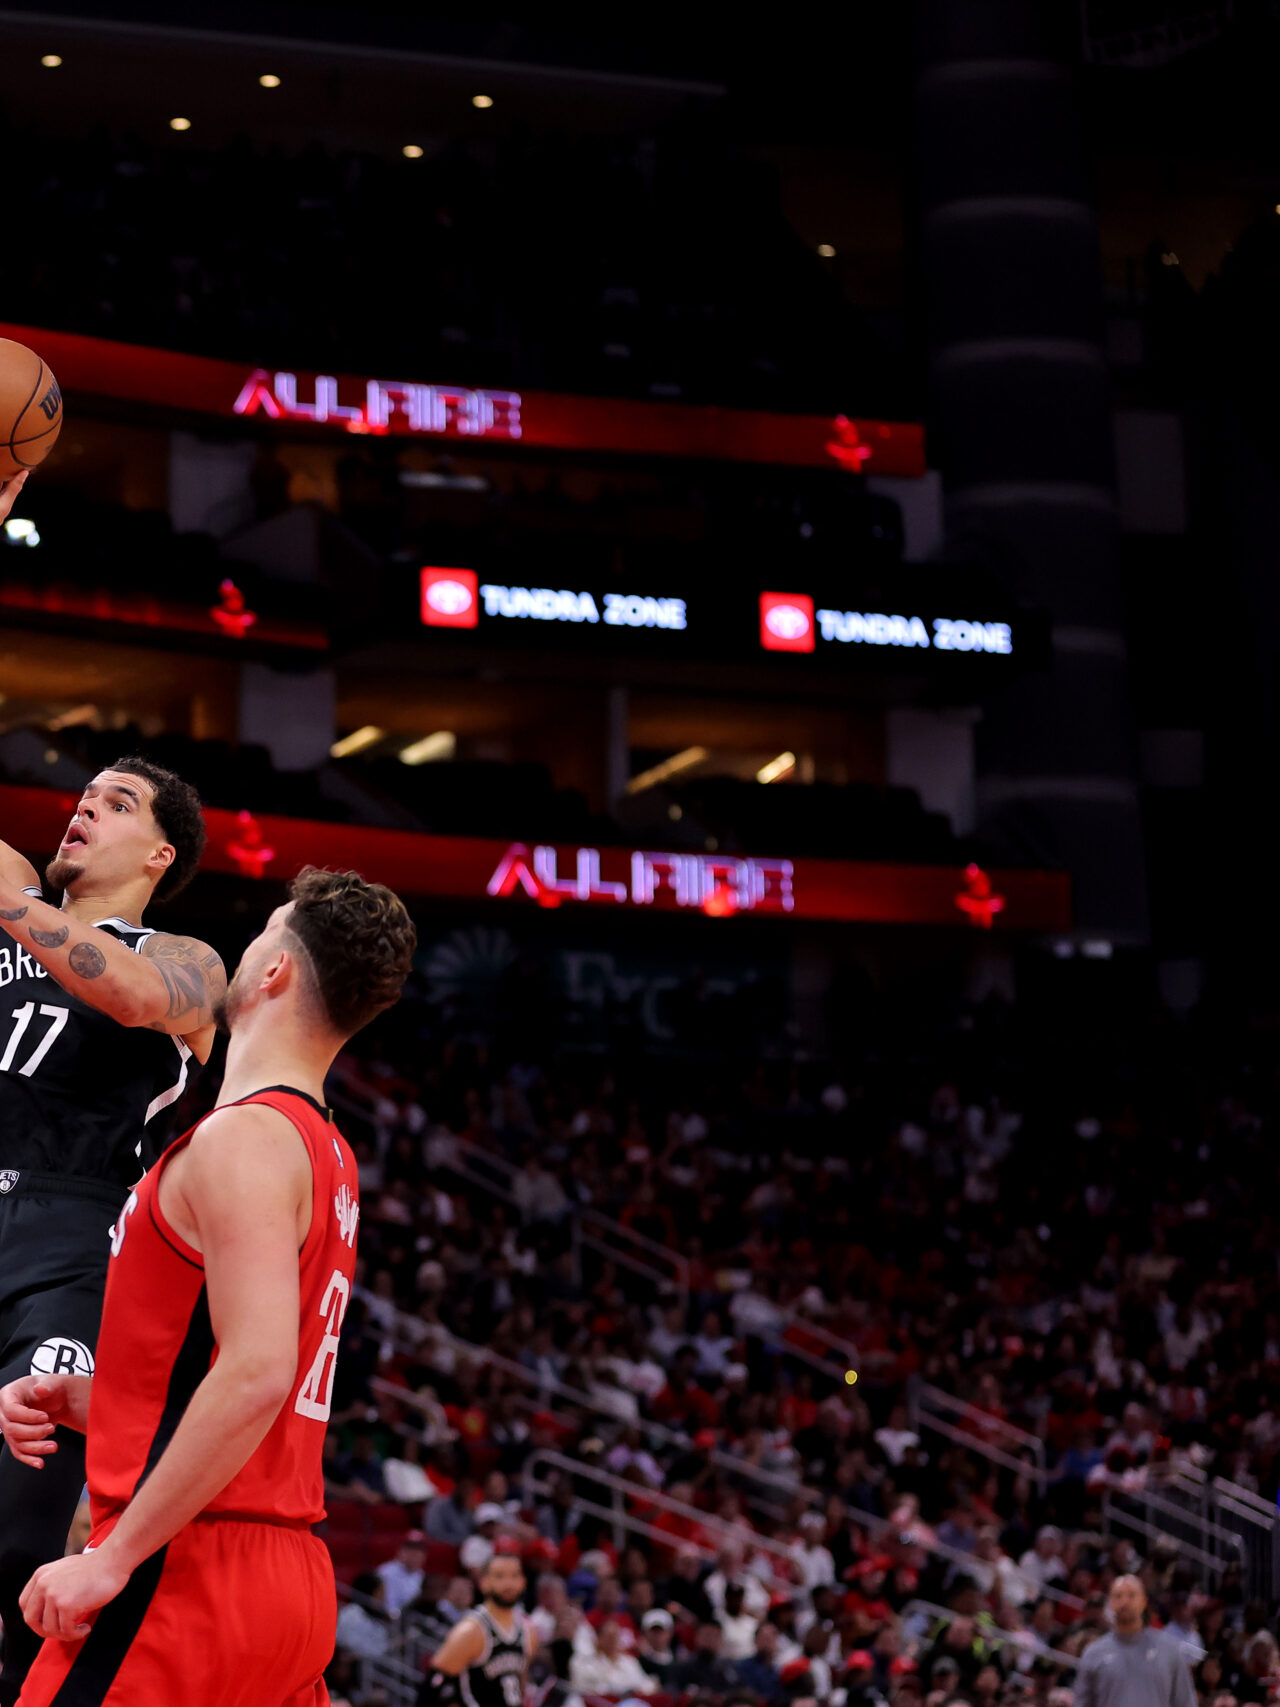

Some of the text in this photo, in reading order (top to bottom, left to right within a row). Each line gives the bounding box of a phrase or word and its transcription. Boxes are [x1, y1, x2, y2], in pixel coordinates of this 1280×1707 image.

[232, 368, 364, 424] ALL
[479, 584, 688, 631] TUNDRA ZONE
[815, 608, 1014, 655] TUNDRA ZONE
[486, 842, 628, 902] ALL
